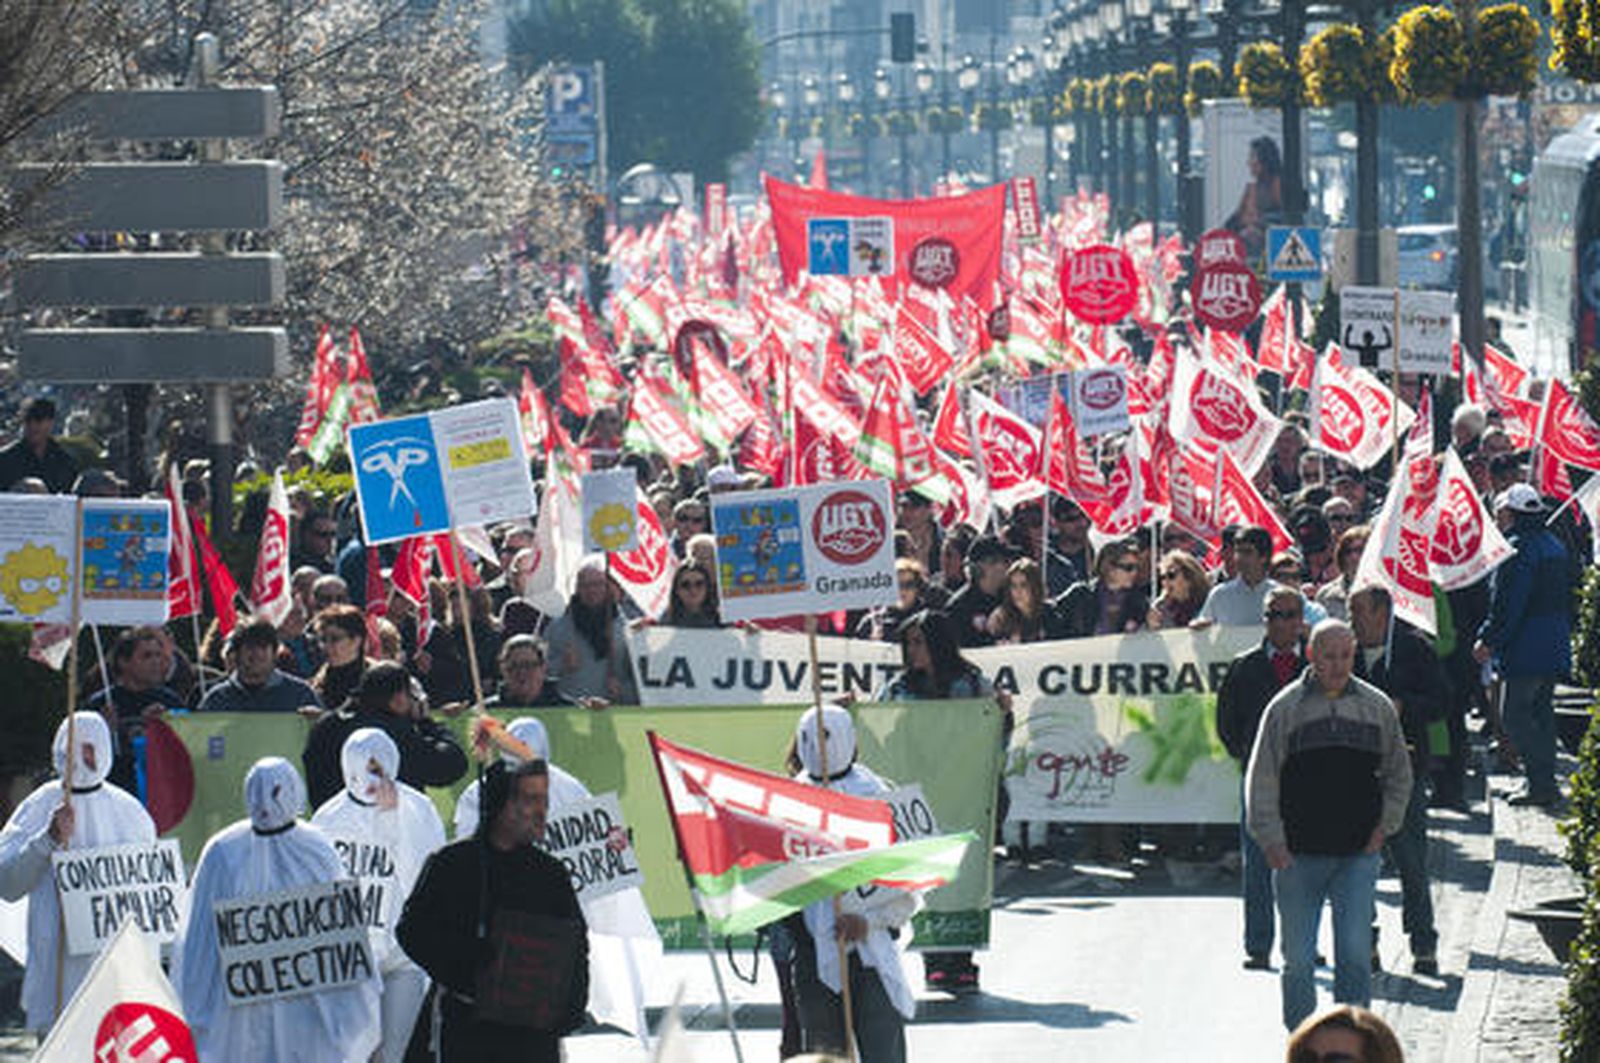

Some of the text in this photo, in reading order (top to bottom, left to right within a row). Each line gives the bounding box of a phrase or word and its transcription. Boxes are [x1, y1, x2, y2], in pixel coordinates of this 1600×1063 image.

[551, 73, 583, 112] P
[1072, 250, 1125, 285] UGT
[1202, 272, 1251, 300] UGT
[822, 500, 877, 530] UGT
[816, 573, 893, 595] Granada
[638, 654, 695, 689] LA
[993, 665, 1021, 695] A
[216, 881, 363, 948] NEGOCIACIÓN
[226, 941, 373, 998] COLECTIVA
